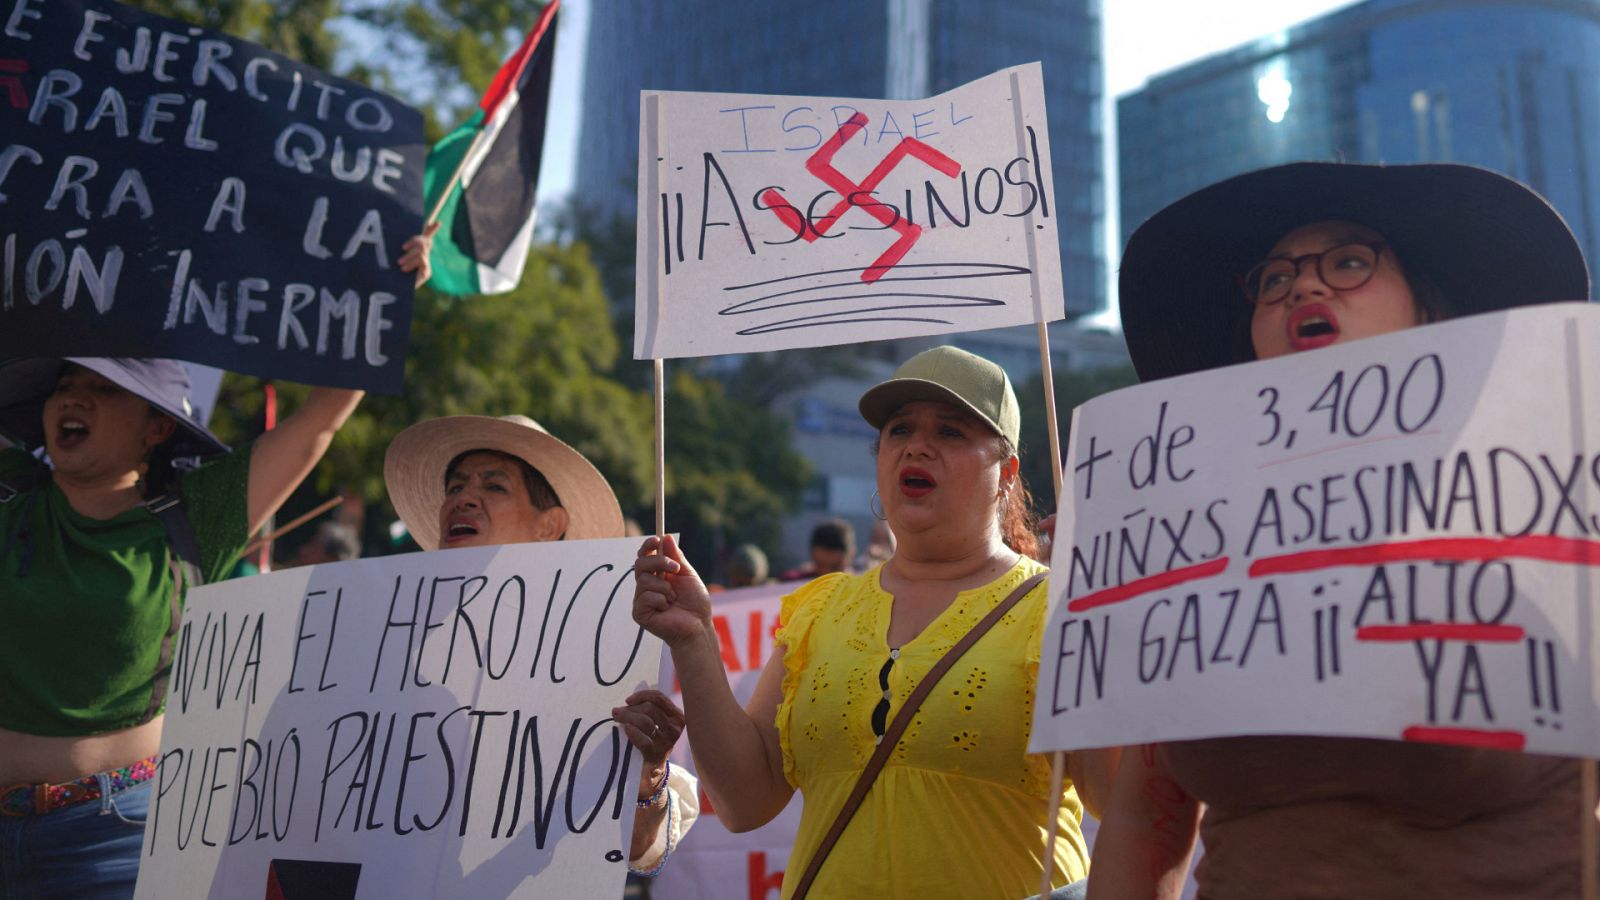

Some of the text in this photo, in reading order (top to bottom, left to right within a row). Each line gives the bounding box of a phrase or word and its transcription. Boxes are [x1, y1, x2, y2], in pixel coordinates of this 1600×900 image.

[274, 123, 405, 195] QUE
[719, 102, 975, 154] ISRAEL
[204, 177, 247, 233] A
[303, 196, 390, 270] LA
[163, 249, 398, 367] INERME
[1129, 402, 1196, 490] de
[1257, 354, 1445, 449] 3,400
[1067, 499, 1229, 599] NIÑXS
[289, 588, 343, 694] EL
[370, 563, 645, 694] HEROICO
[1051, 614, 1110, 717] EN
[1138, 582, 1287, 685] GAZA
[150, 727, 301, 857] PUEBLO
